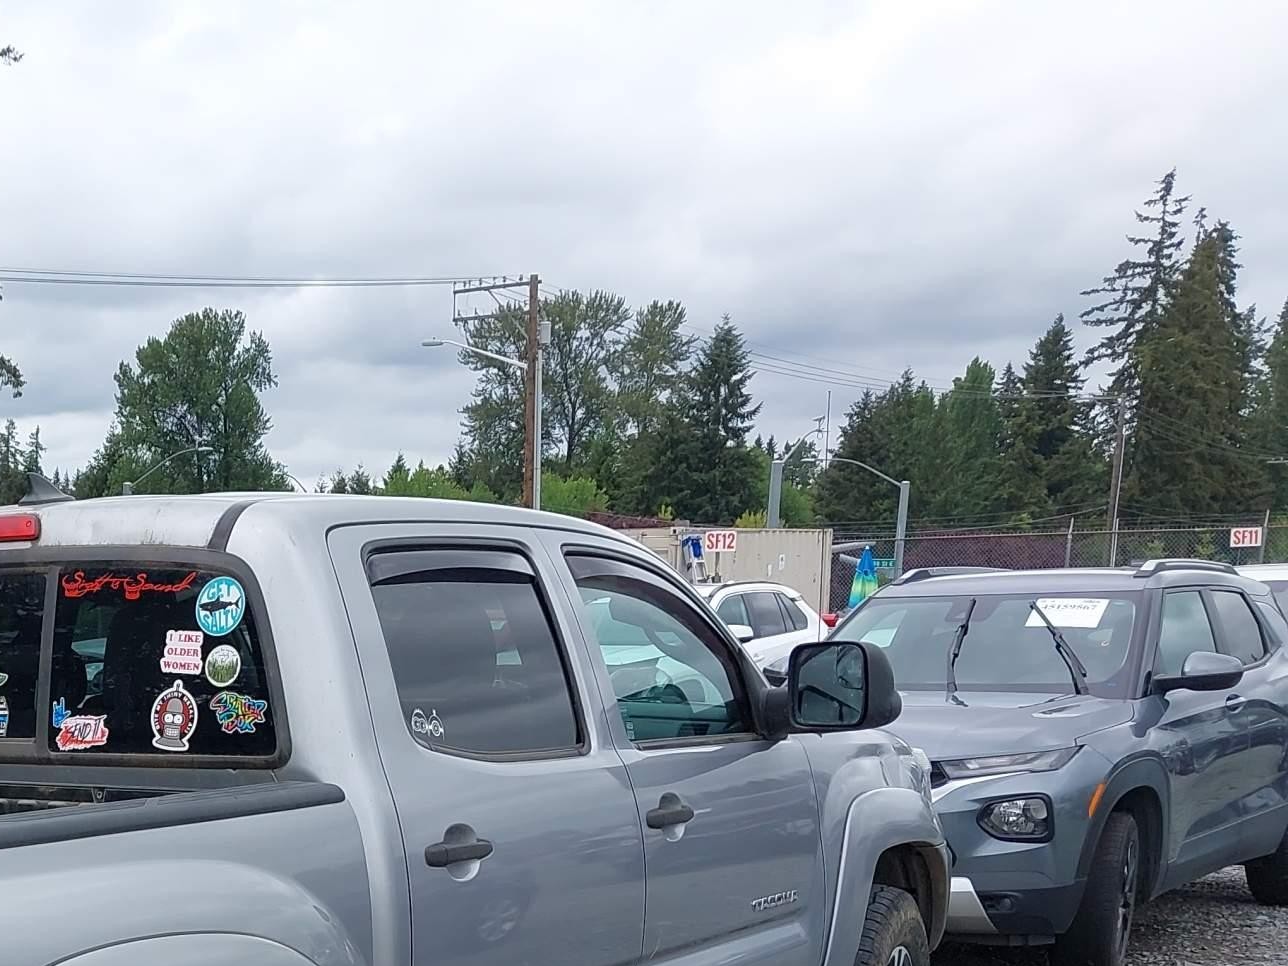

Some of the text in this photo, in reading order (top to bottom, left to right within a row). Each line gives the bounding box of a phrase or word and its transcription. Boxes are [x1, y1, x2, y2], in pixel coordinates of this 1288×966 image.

[706, 533, 735, 549] SF12
[1233, 529, 1258, 545] SF11
[207, 580, 233, 600] GET
[202, 608, 239, 632] SALTY
[169, 633, 201, 643] I LIKE
[167, 647, 199, 657] OLDER
[163, 660, 201, 671] WOMEN
